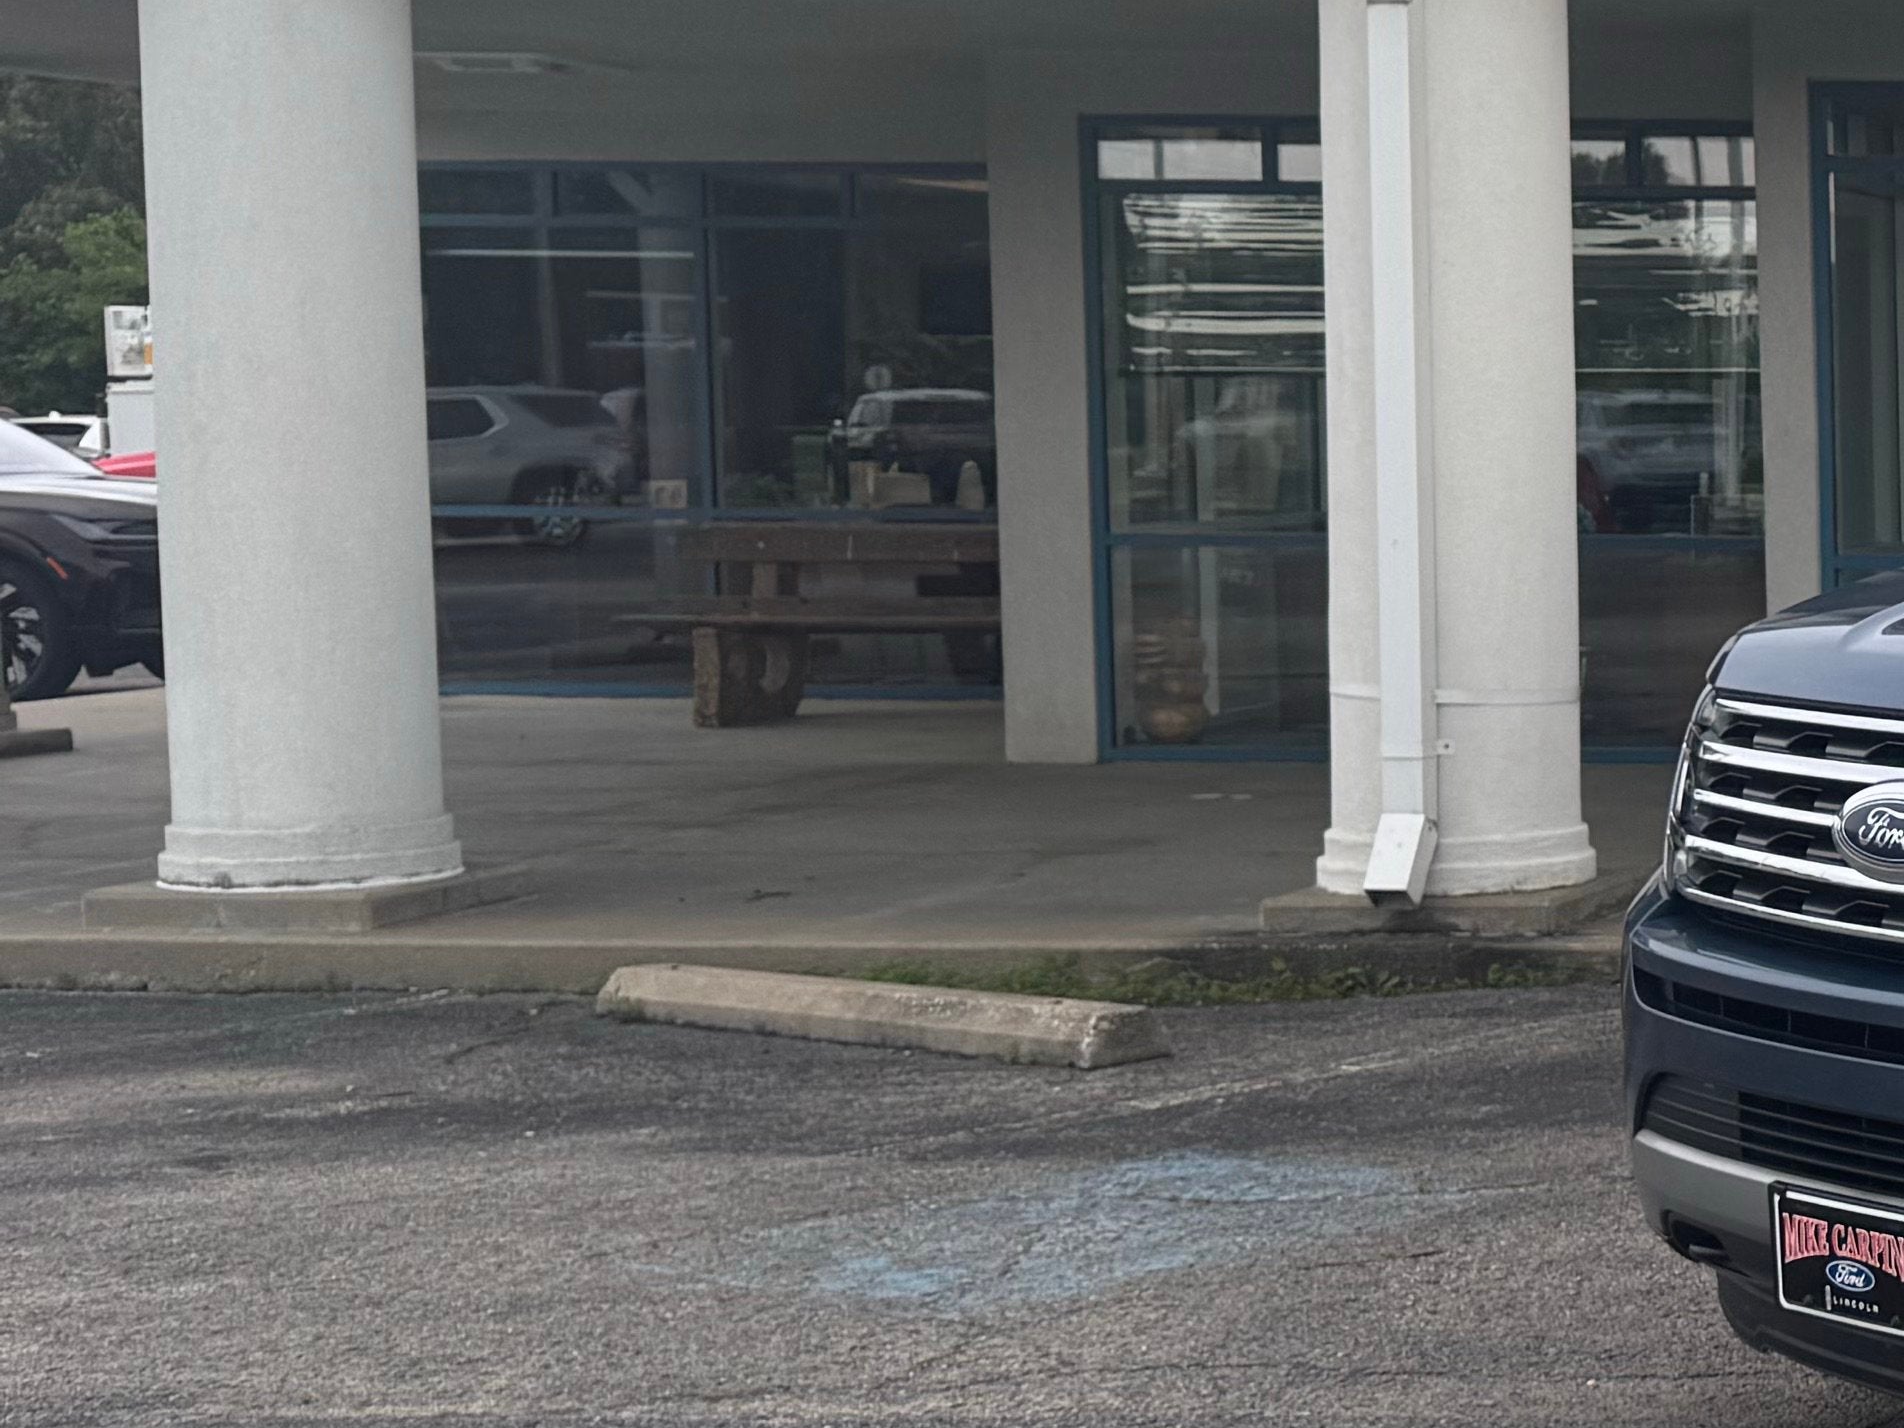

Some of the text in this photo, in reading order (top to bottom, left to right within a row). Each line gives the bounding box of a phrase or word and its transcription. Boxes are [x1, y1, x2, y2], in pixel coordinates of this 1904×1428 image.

[1782, 1212, 1830, 1264] MIKE
[1834, 1263, 1866, 1288] Ford
[1832, 1295, 1880, 1314] LINCOLN
